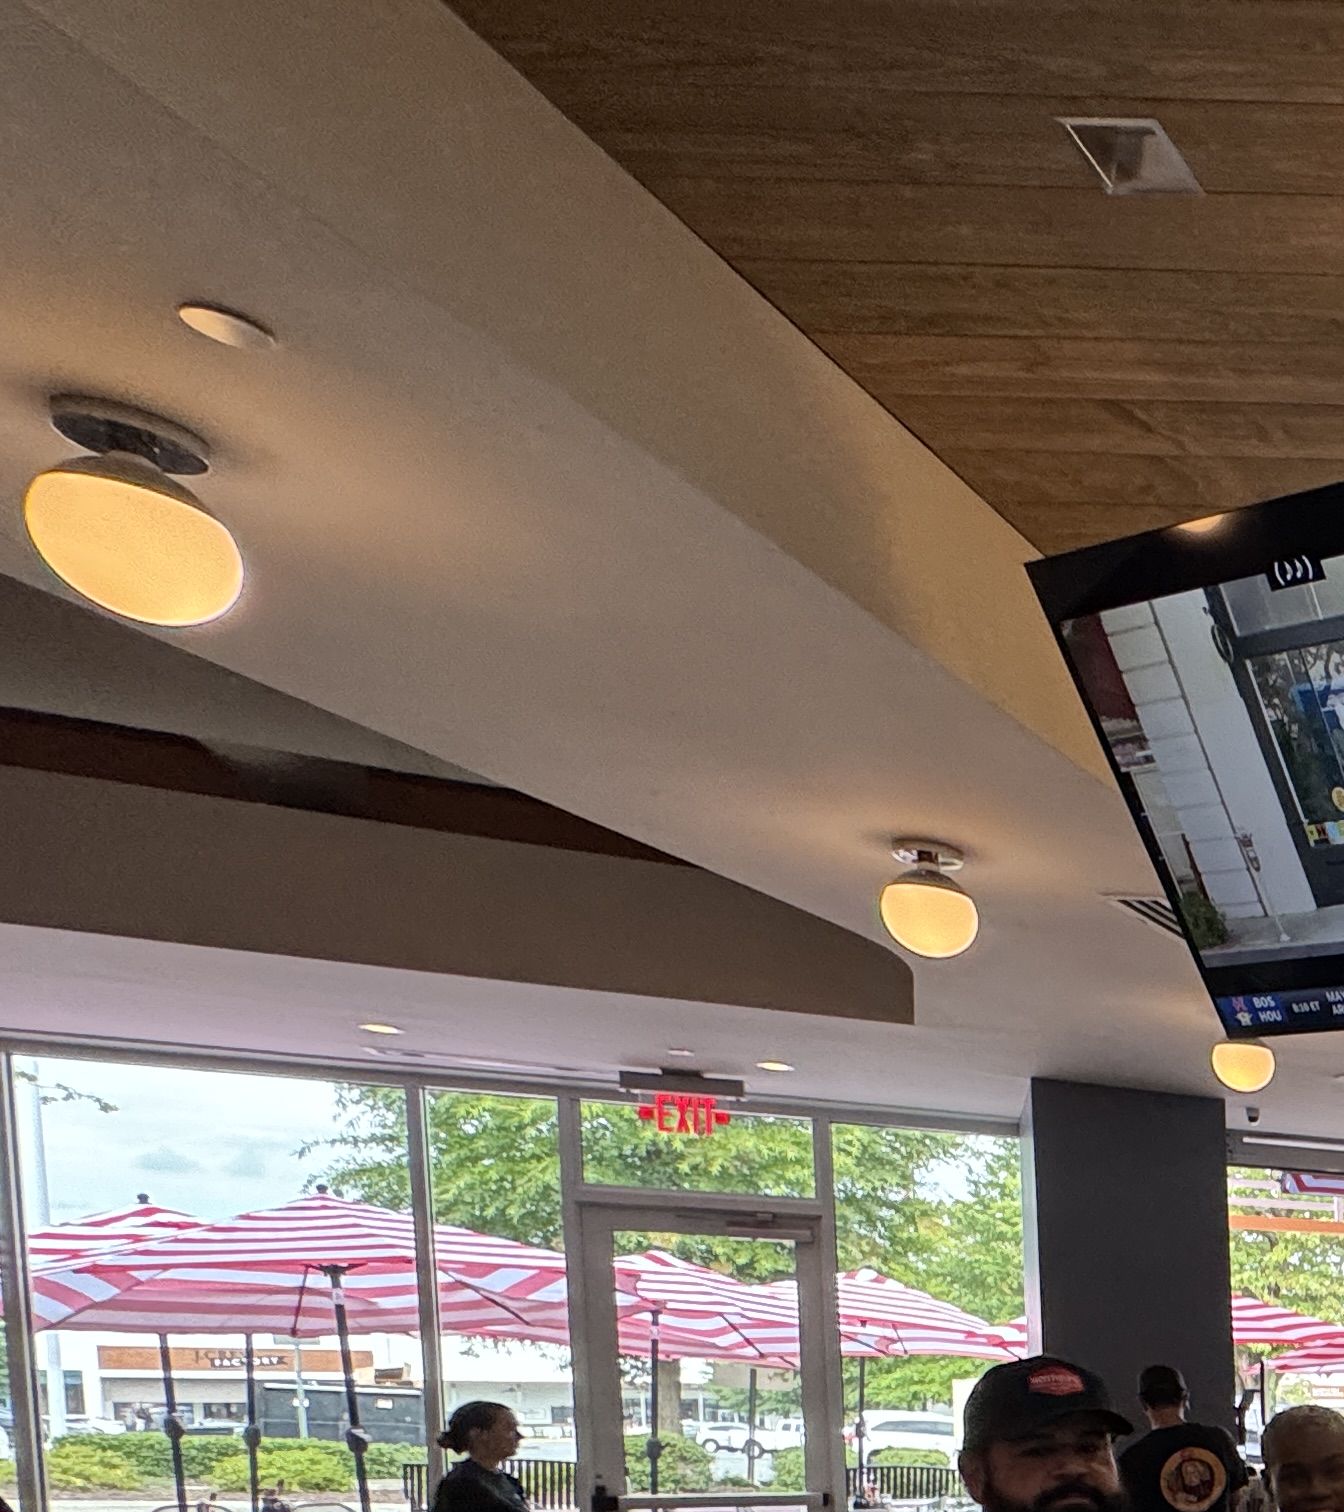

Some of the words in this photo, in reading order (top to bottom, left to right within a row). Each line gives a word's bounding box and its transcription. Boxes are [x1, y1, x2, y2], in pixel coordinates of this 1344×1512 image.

[1252, 995, 1276, 1008] BOS
[1257, 1010, 1282, 1022] HOU
[656, 1094, 717, 1136] EXIT
